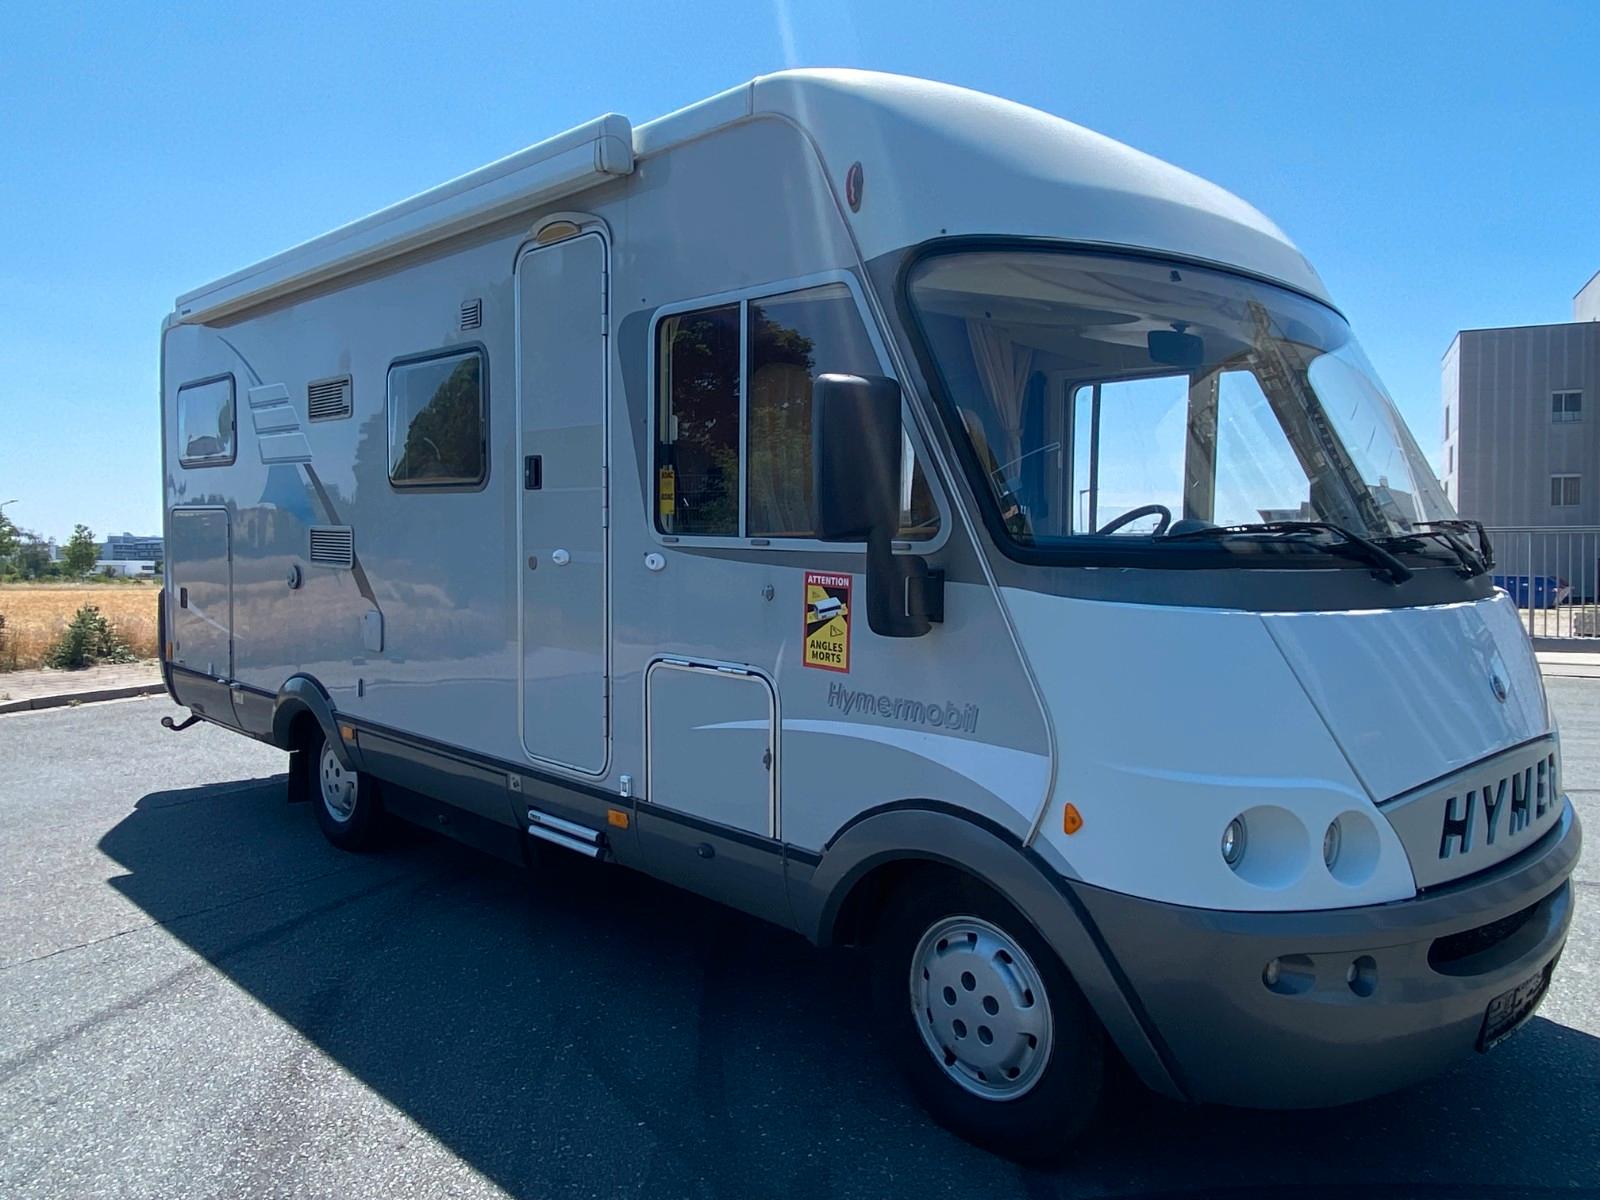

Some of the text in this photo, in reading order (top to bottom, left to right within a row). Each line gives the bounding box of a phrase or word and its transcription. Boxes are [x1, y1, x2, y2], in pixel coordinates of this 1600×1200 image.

[807, 575, 849, 587] ATTENTION
[810, 639, 843, 653] ANGLES
[811, 650, 842, 664] MORTS
[827, 681, 979, 733] Hymermobil
